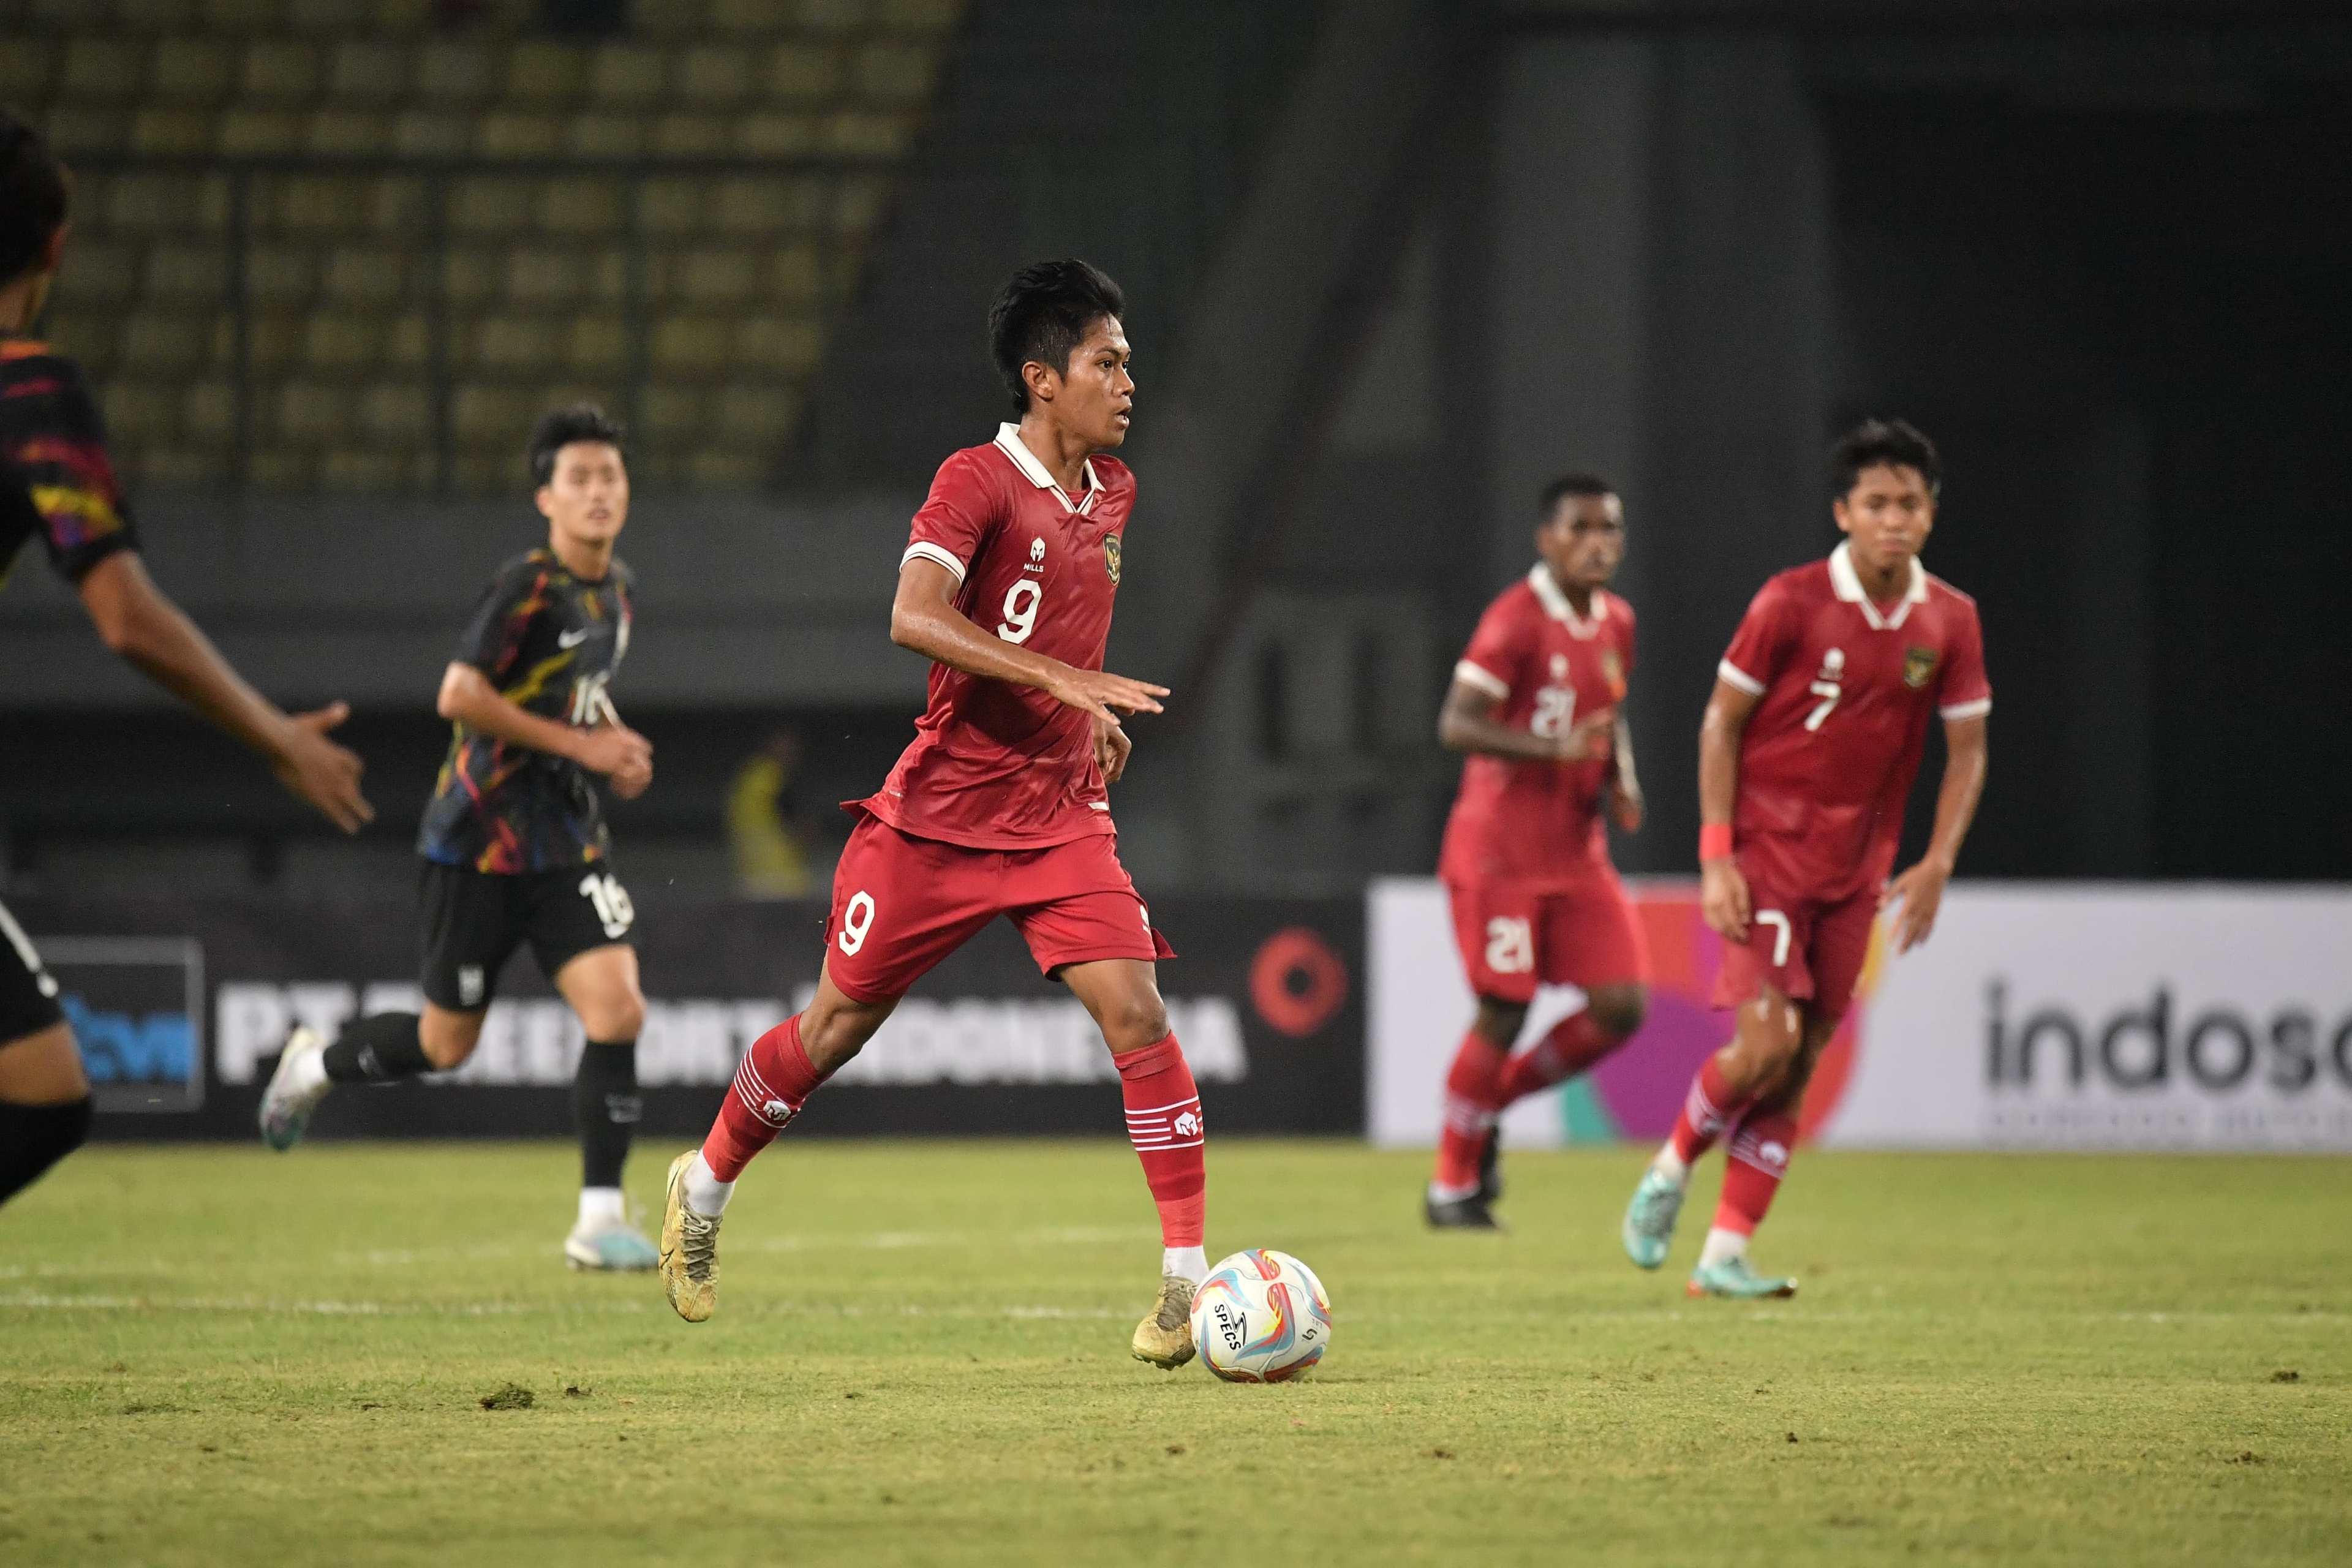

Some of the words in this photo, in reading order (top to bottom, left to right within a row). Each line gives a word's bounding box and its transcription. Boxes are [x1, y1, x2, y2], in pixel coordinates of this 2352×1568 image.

[1023, 562, 1044, 573] MILLS
[997, 578, 1042, 644] 9
[1804, 680, 1841, 731] 7
[839, 890, 875, 957] 9
[1485, 916, 1534, 974] 21
[1755, 910, 1792, 967] 7
[216, 982, 354, 1085] PT
[1215, 1304, 1242, 1351] SPECS
